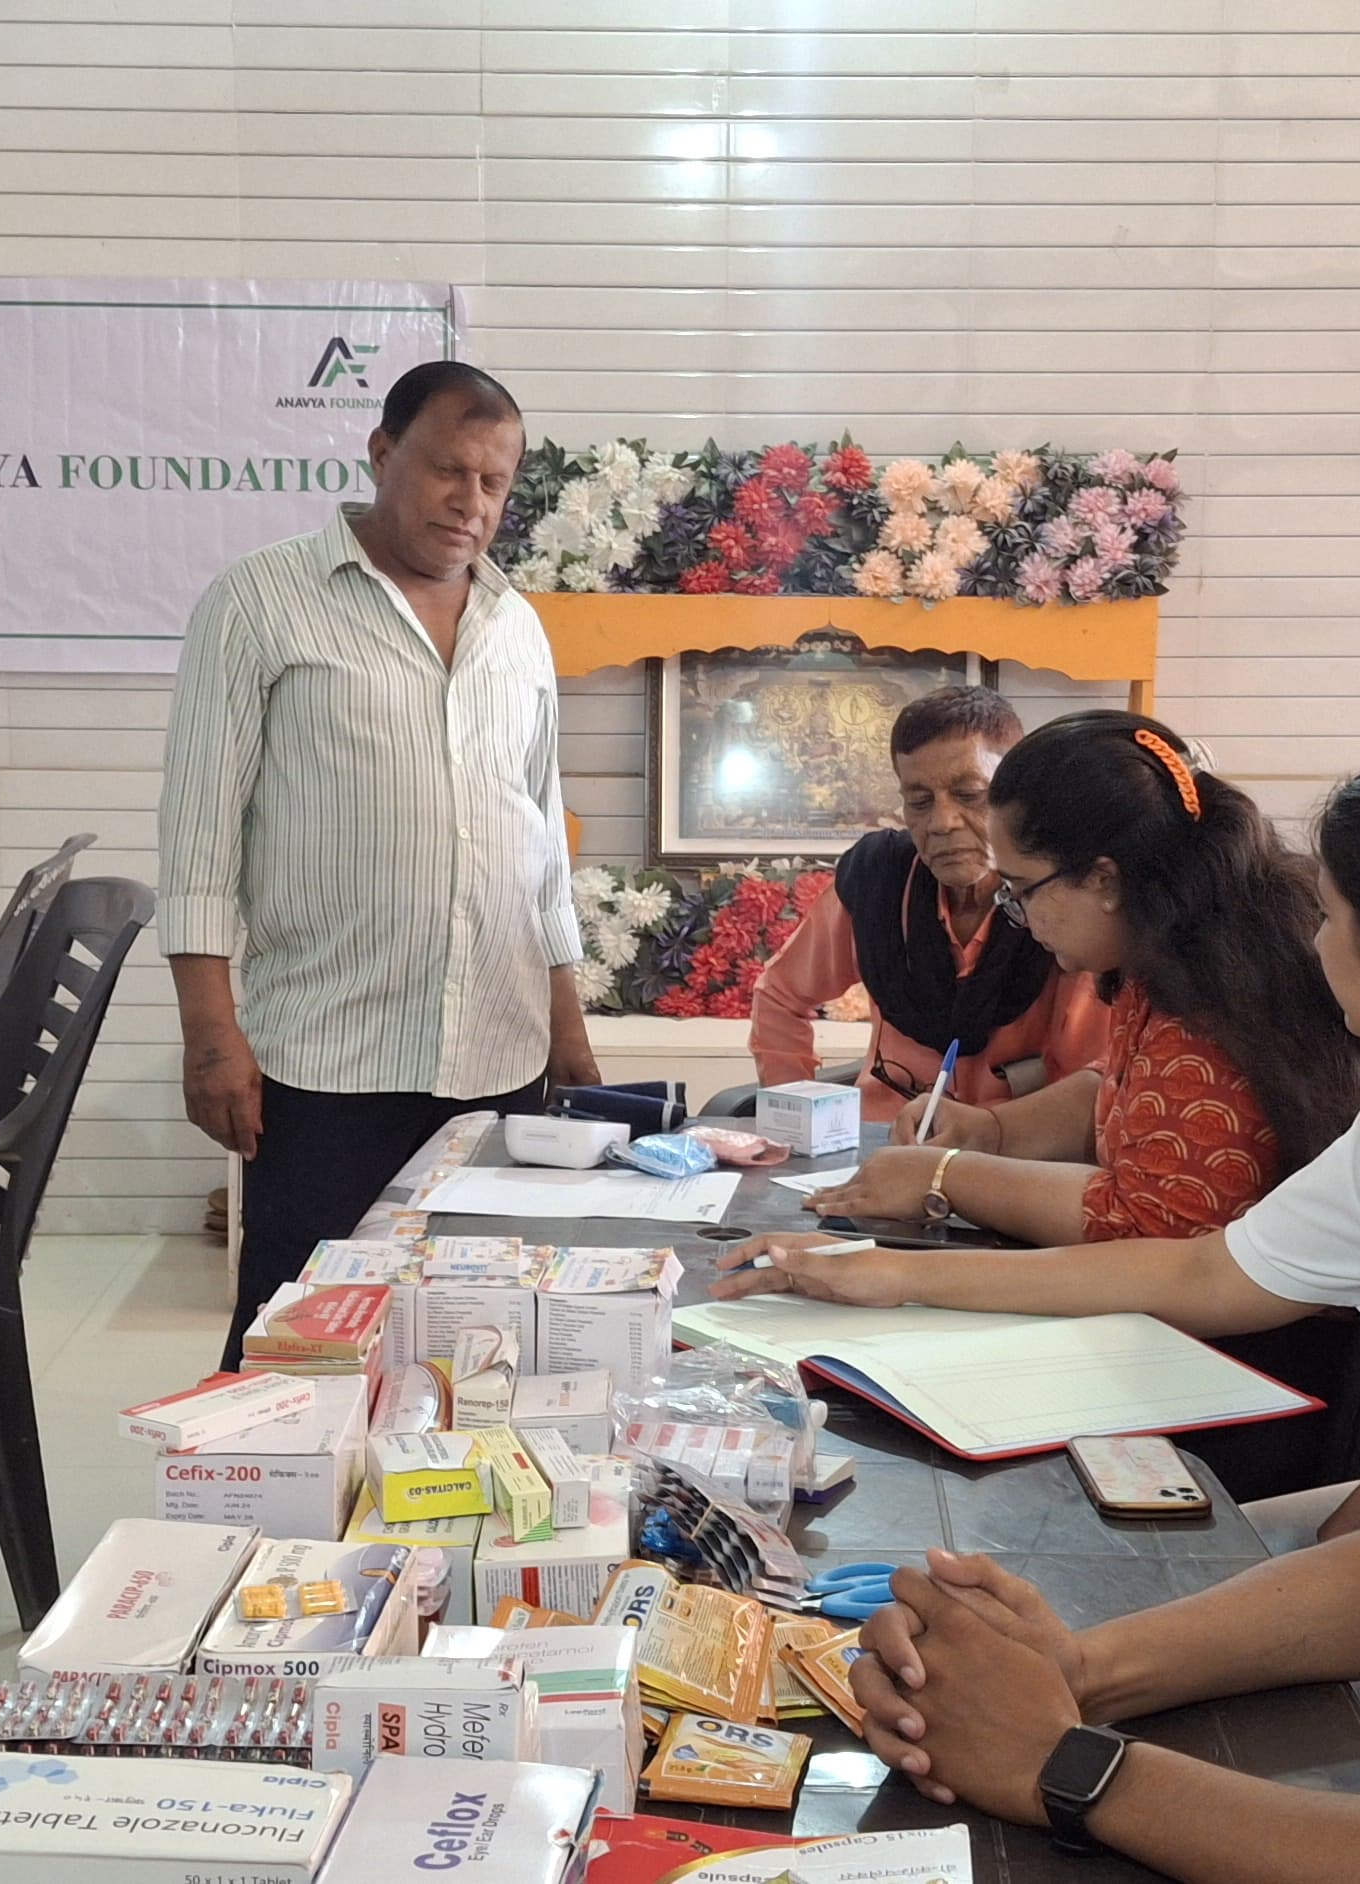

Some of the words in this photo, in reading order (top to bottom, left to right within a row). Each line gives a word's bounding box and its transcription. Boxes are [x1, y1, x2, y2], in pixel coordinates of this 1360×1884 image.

[276, 397, 326, 409] ANAVYA
[330, 398, 385, 409] FOUNDA
[165, 1464, 262, 1482] Cefix-200
[408, 1481, 473, 1496] CALCITAS-D3
[106, 1569, 156, 1620] PARACIP-650
[622, 1584, 655, 1631] ORS
[203, 1658, 276, 1678] Cipmox
[282, 1660, 320, 1676] 500
[325, 1702, 341, 1750] Cipla
[381, 1711, 401, 1751] SPA
[417, 1701, 453, 1757] Hydro
[696, 1720, 774, 1748] ORS
[262, 1775, 327, 1790] Cipla
[156, 1798, 315, 1821] Fluka-150
[482, 1803, 505, 1827] Drops
[112, 1815, 305, 1843] Fluconazole
[413, 1792, 487, 1870] Ceflox
[799, 1835, 878, 1856] Capsules
[184, 1875, 201, 1884] 50
[252, 1876, 293, 1884] Tablet
[698, 1871, 763, 1884] apsule
